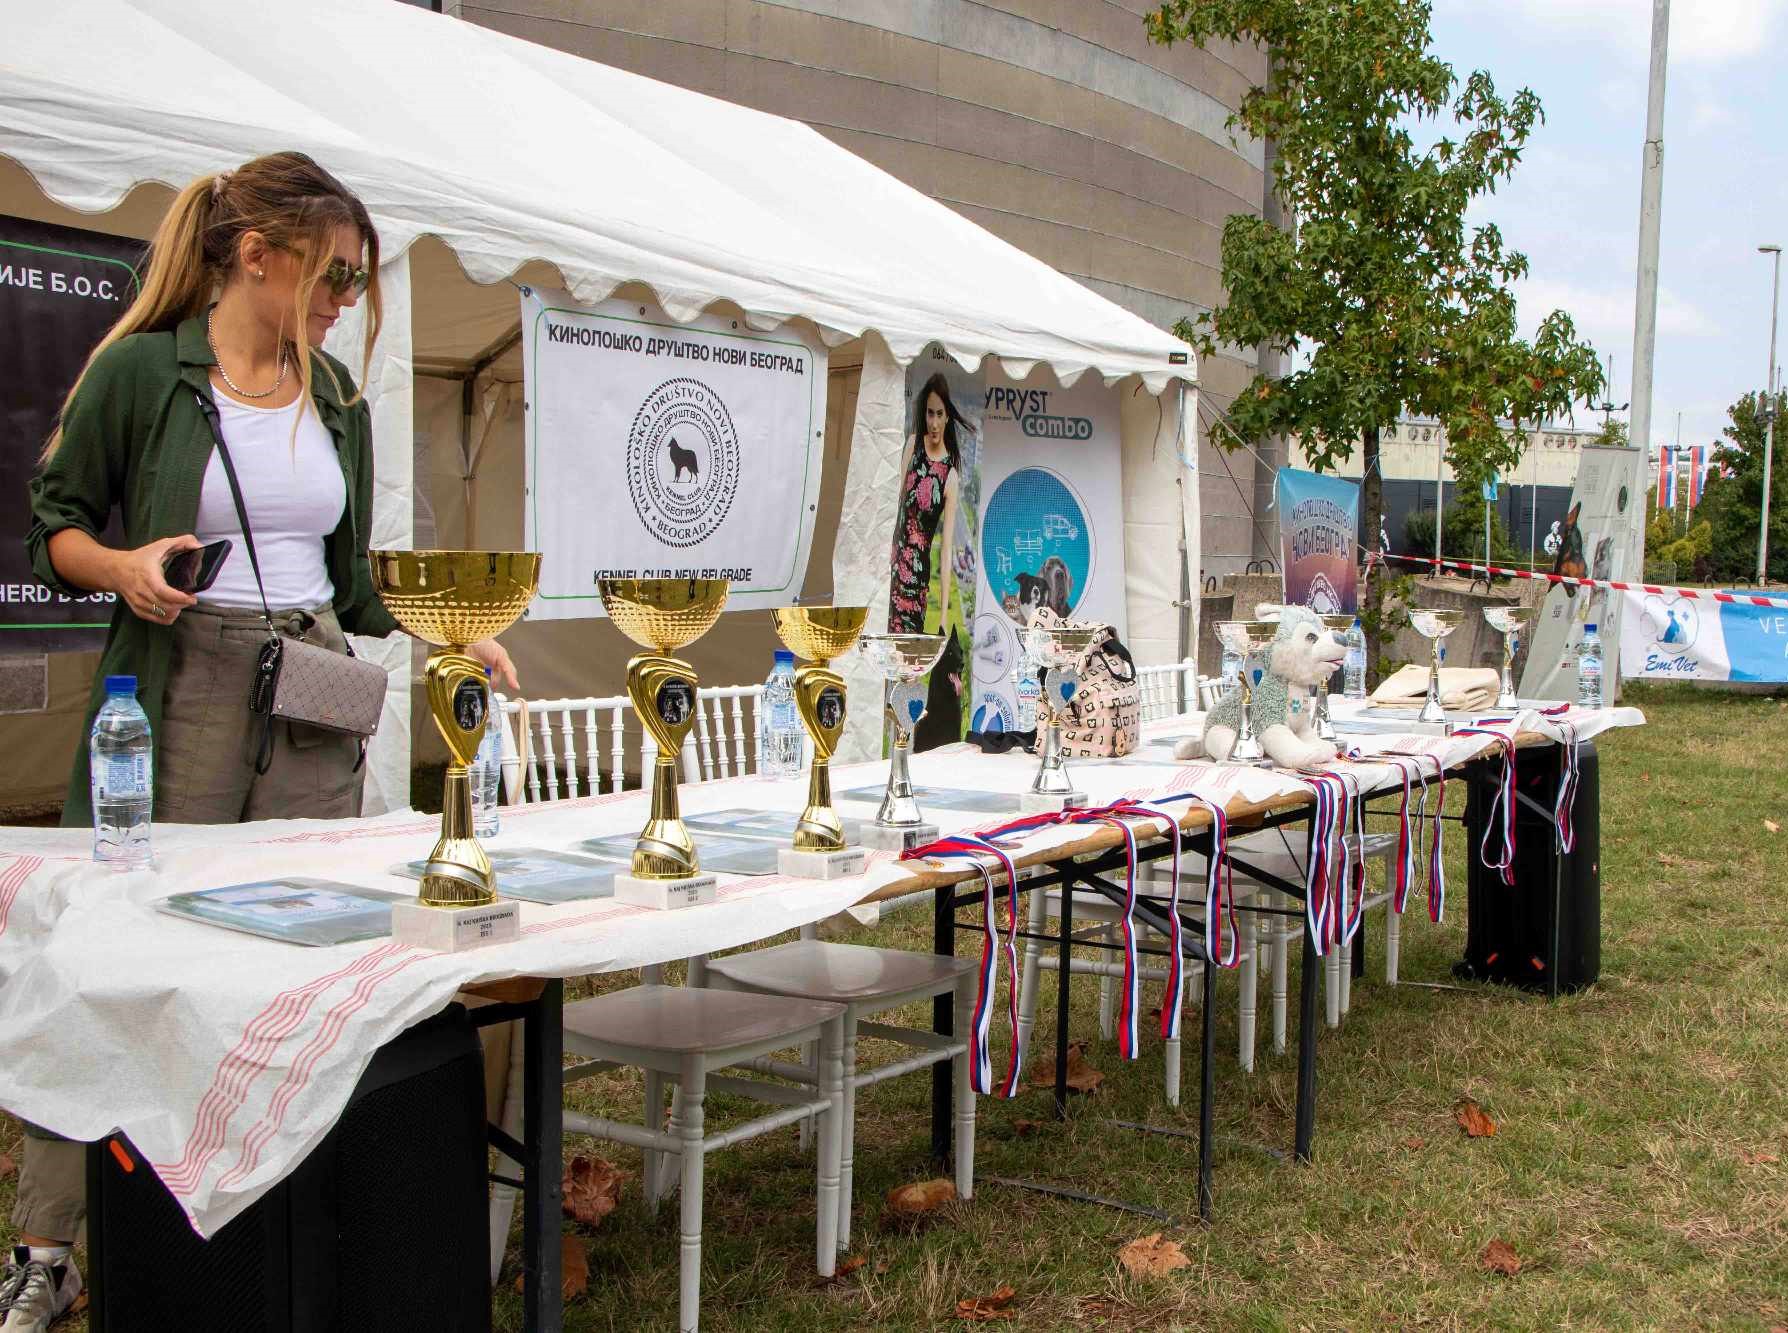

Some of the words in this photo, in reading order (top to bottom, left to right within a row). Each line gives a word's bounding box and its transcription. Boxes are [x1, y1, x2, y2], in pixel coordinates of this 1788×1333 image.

[50, 272, 119, 302] Б.О.С.
[548, 323, 643, 353] КИНОЛОШКО
[646, 337, 710, 361] ДРУШТВО
[712, 346, 747, 367] НОВИ
[750, 351, 804, 375] БЕОГРАД
[651, 385, 704, 414] DRUŠTVO
[663, 409, 702, 429] ДРУШТВО
[706, 398, 730, 436] NOVI
[1024, 415, 1091, 439] combo
[713, 439, 736, 516] BEOGRAD
[664, 502, 702, 518] БЕОГРАД
[657, 520, 707, 540] BEOGRAD
[1645, 654, 1673, 672] Emi
